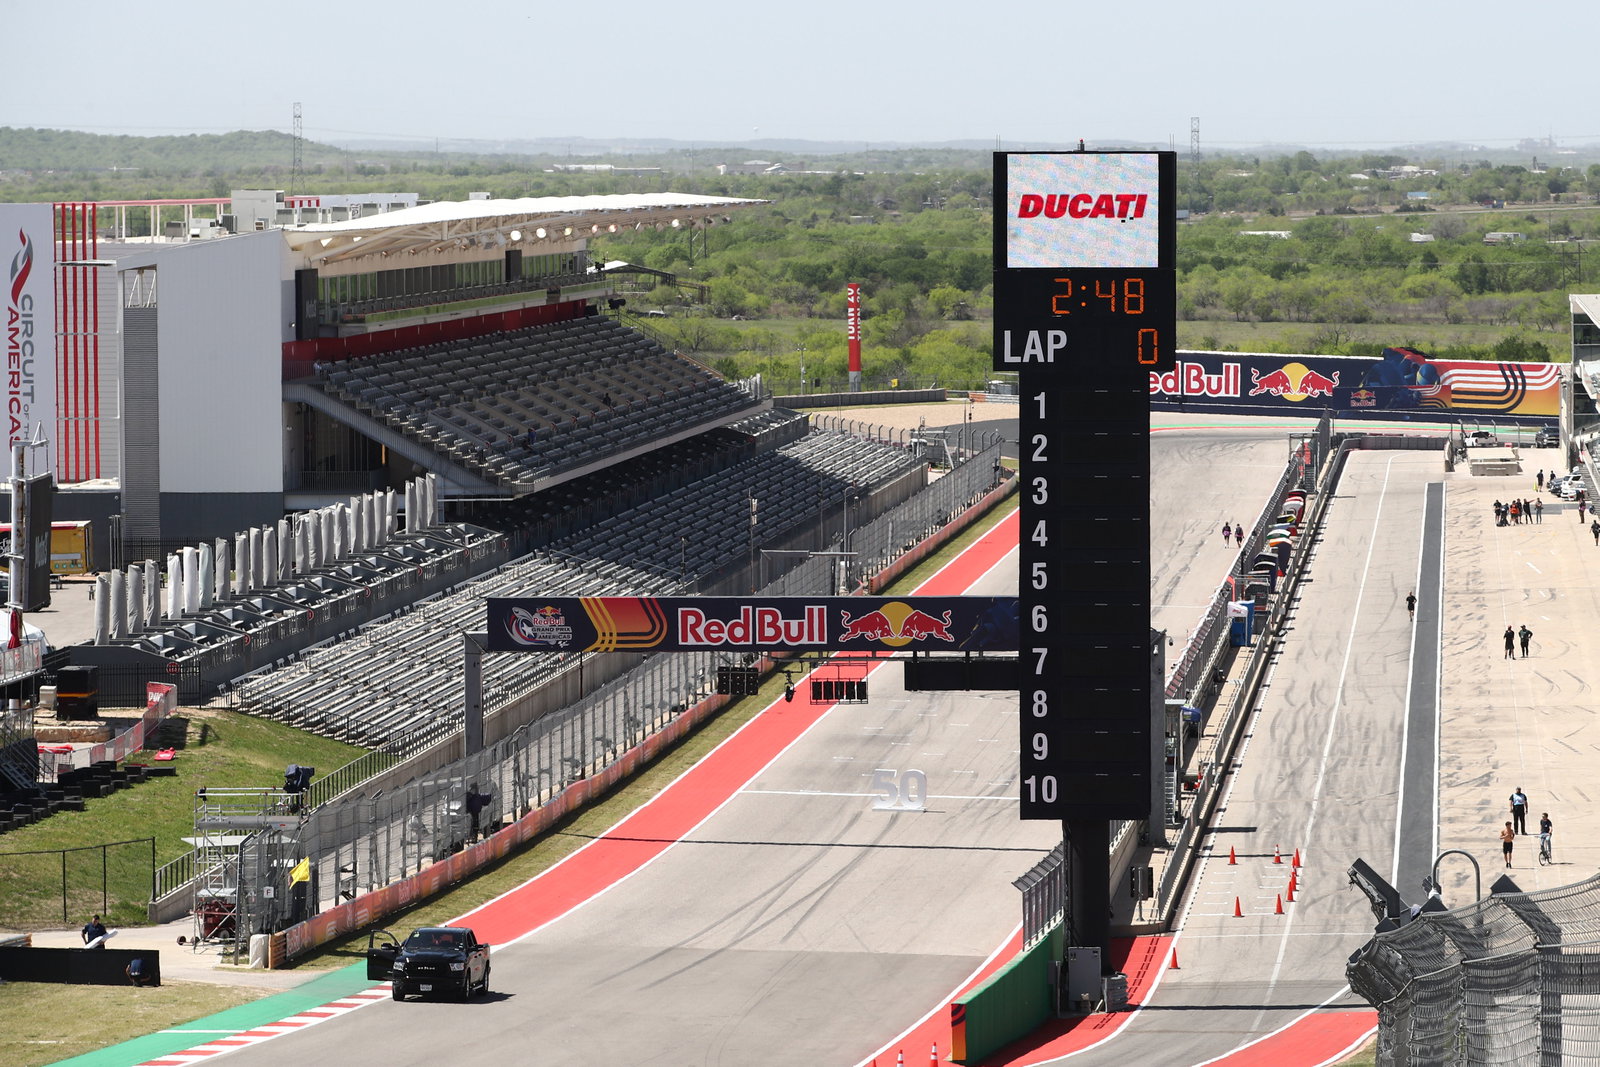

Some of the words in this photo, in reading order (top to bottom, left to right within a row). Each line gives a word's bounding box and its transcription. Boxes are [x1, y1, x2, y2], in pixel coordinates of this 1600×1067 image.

[1017, 193, 1148, 218] DUCATI
[1052, 278, 1145, 314] 2:48
[21, 294, 35, 404] CIRCUIT
[1003, 330, 1068, 363] LAP
[1138, 328, 1158, 364] 0
[1149, 361, 1182, 396] ed
[1183, 362, 1241, 397] Bull
[23, 403, 30, 420] OF
[1034, 391, 1046, 419] 1
[1032, 434, 1048, 462] 2
[1032, 477, 1049, 505] 3
[1032, 520, 1049, 547] 4
[1032, 562, 1048, 590] 5
[678, 606, 753, 646] Red
[755, 606, 828, 646] Bull
[1031, 605, 1048, 633] 6
[1032, 648, 1049, 675] 7
[1032, 690, 1049, 718] 8
[1032, 732, 1049, 760] 9
[871, 768, 928, 810] 50
[1024, 775, 1058, 803] 10
